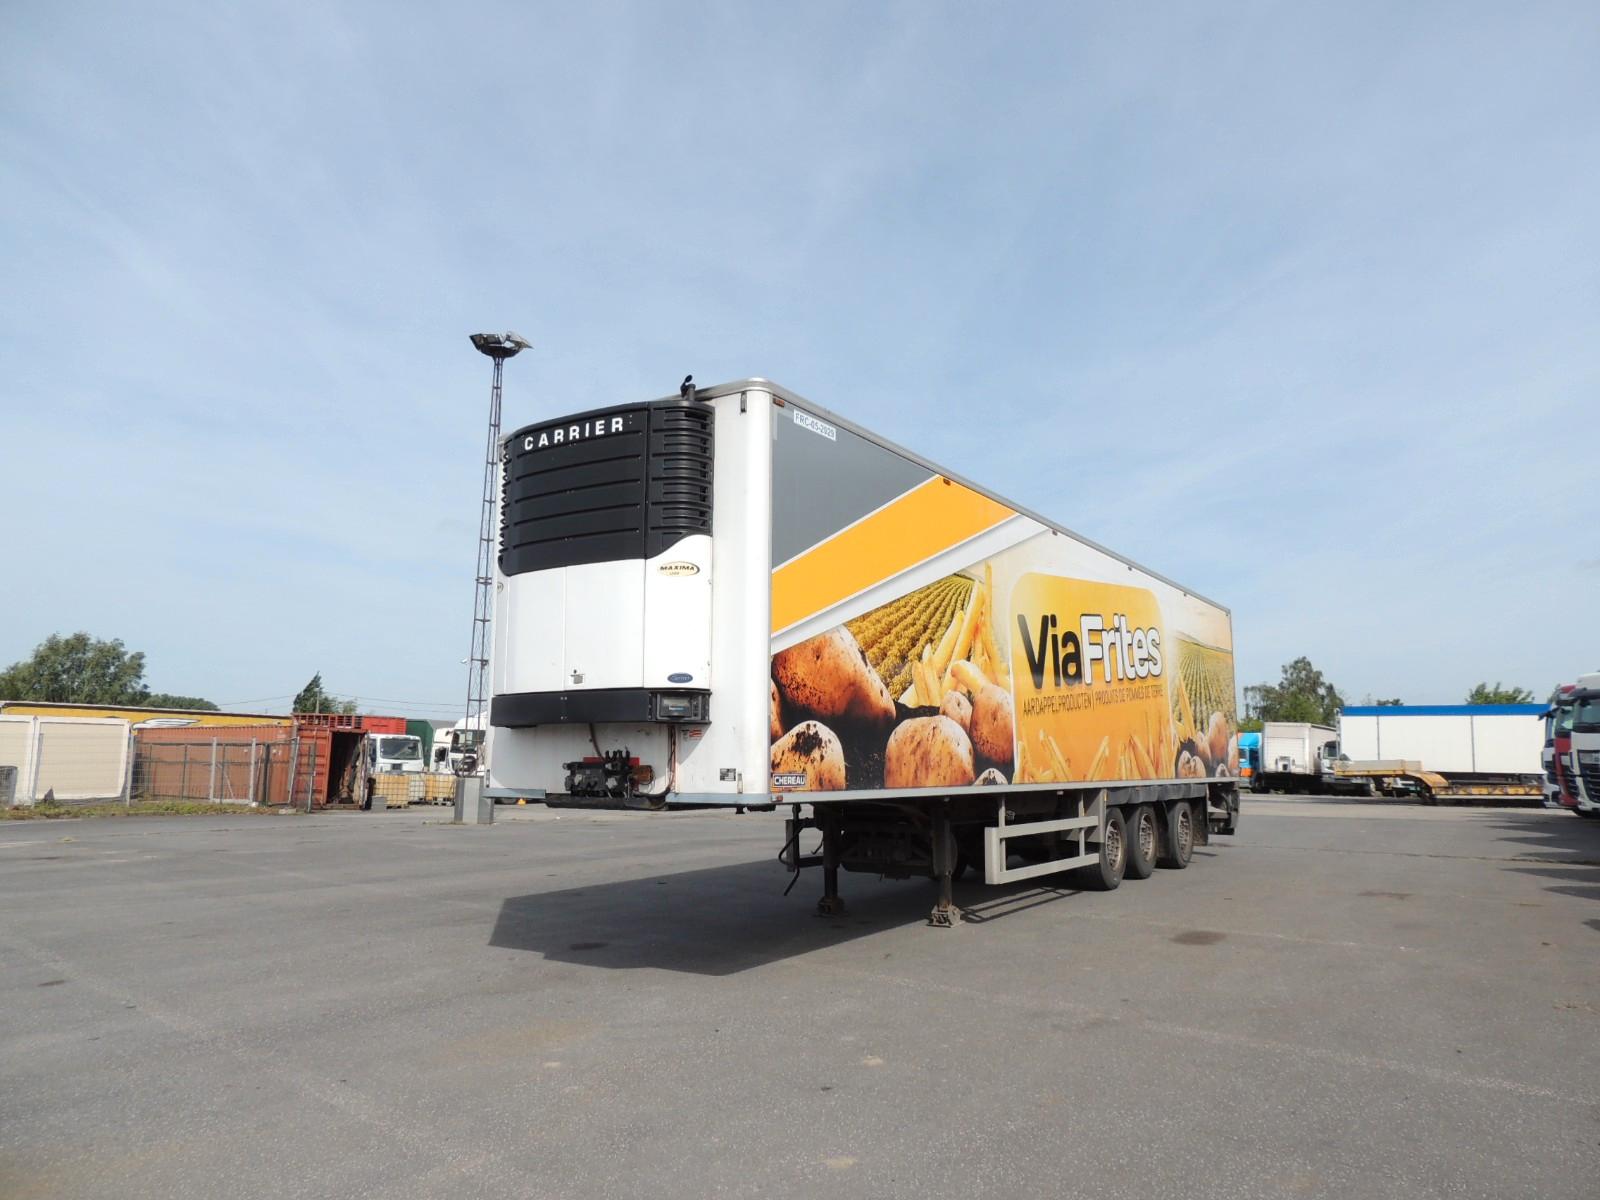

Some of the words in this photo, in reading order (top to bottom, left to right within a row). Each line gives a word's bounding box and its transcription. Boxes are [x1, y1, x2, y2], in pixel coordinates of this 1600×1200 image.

[524, 417, 623, 451] CARRIER
[1017, 612, 1163, 690] ViaFrites
[774, 776, 805, 785] CHEREAU
